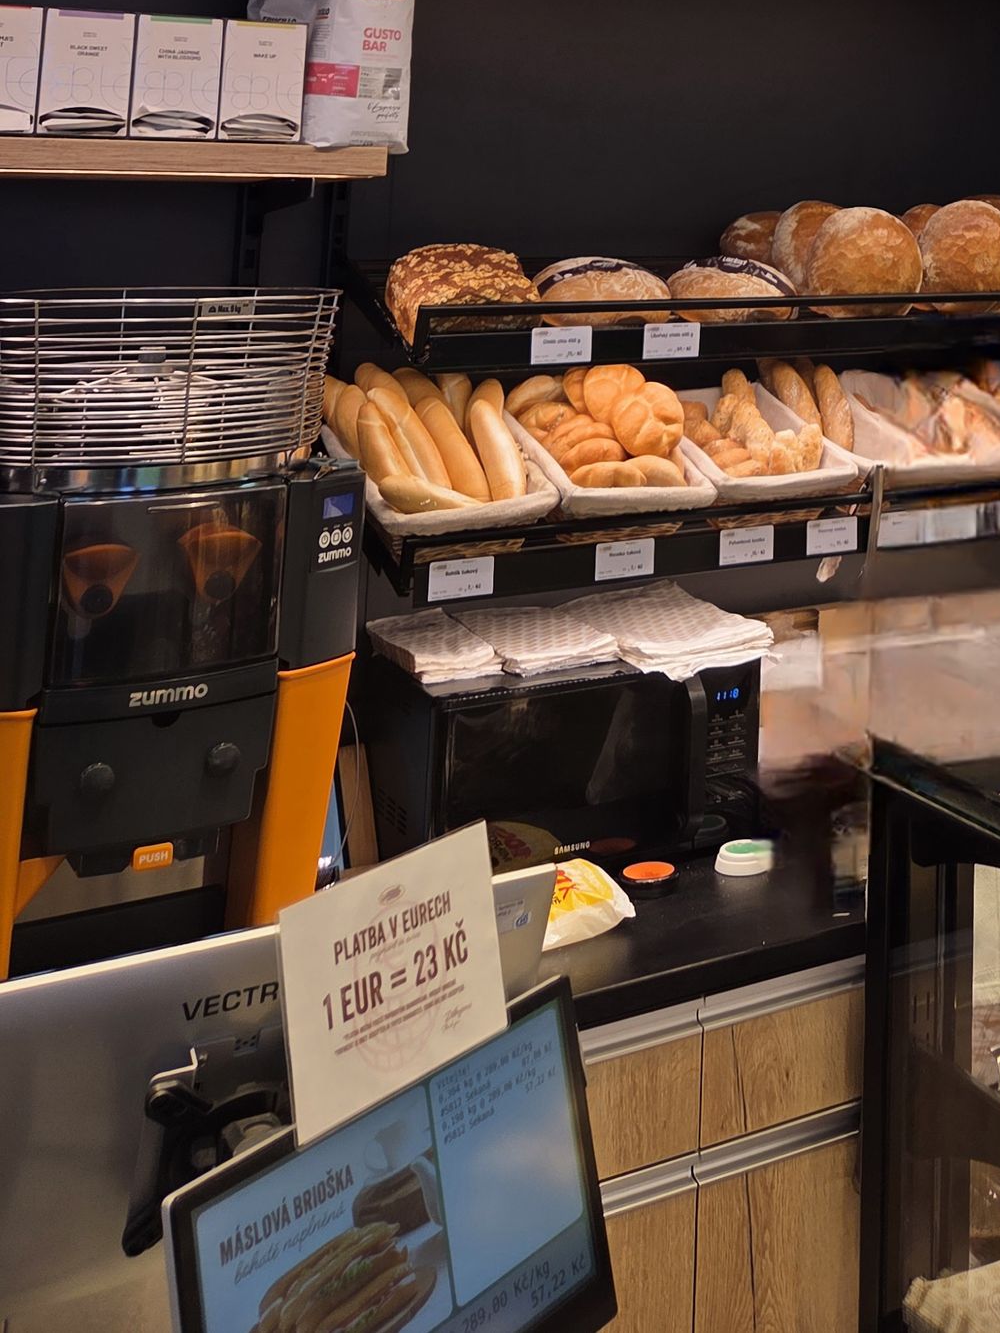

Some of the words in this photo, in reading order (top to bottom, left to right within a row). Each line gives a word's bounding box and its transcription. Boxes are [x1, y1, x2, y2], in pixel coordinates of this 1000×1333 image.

[363, 27, 402, 40] GUSTO
[362, 39, 388, 52] BAR
[318, 546, 352, 564] zummo
[128, 683, 209, 708] zummo
[138, 850, 169, 865] PUSH
[553, 840, 591, 856] SAMSUNG
[333, 921, 387, 966] PLATBA
[388, 914, 398, 940] V
[402, 890, 451, 935] EURECH
[322, 992, 334, 1031] 1
[339, 970, 384, 1023] EUR
[390, 967, 408, 989] =
[413, 943, 439, 987] 23
[442, 918, 469, 972] KČ
[219, 1196, 291, 1268] MÁSLOVÁ
[292, 1164, 354, 1220] BRIOŠKA
[530, 1269, 566, 1309] 57,22
